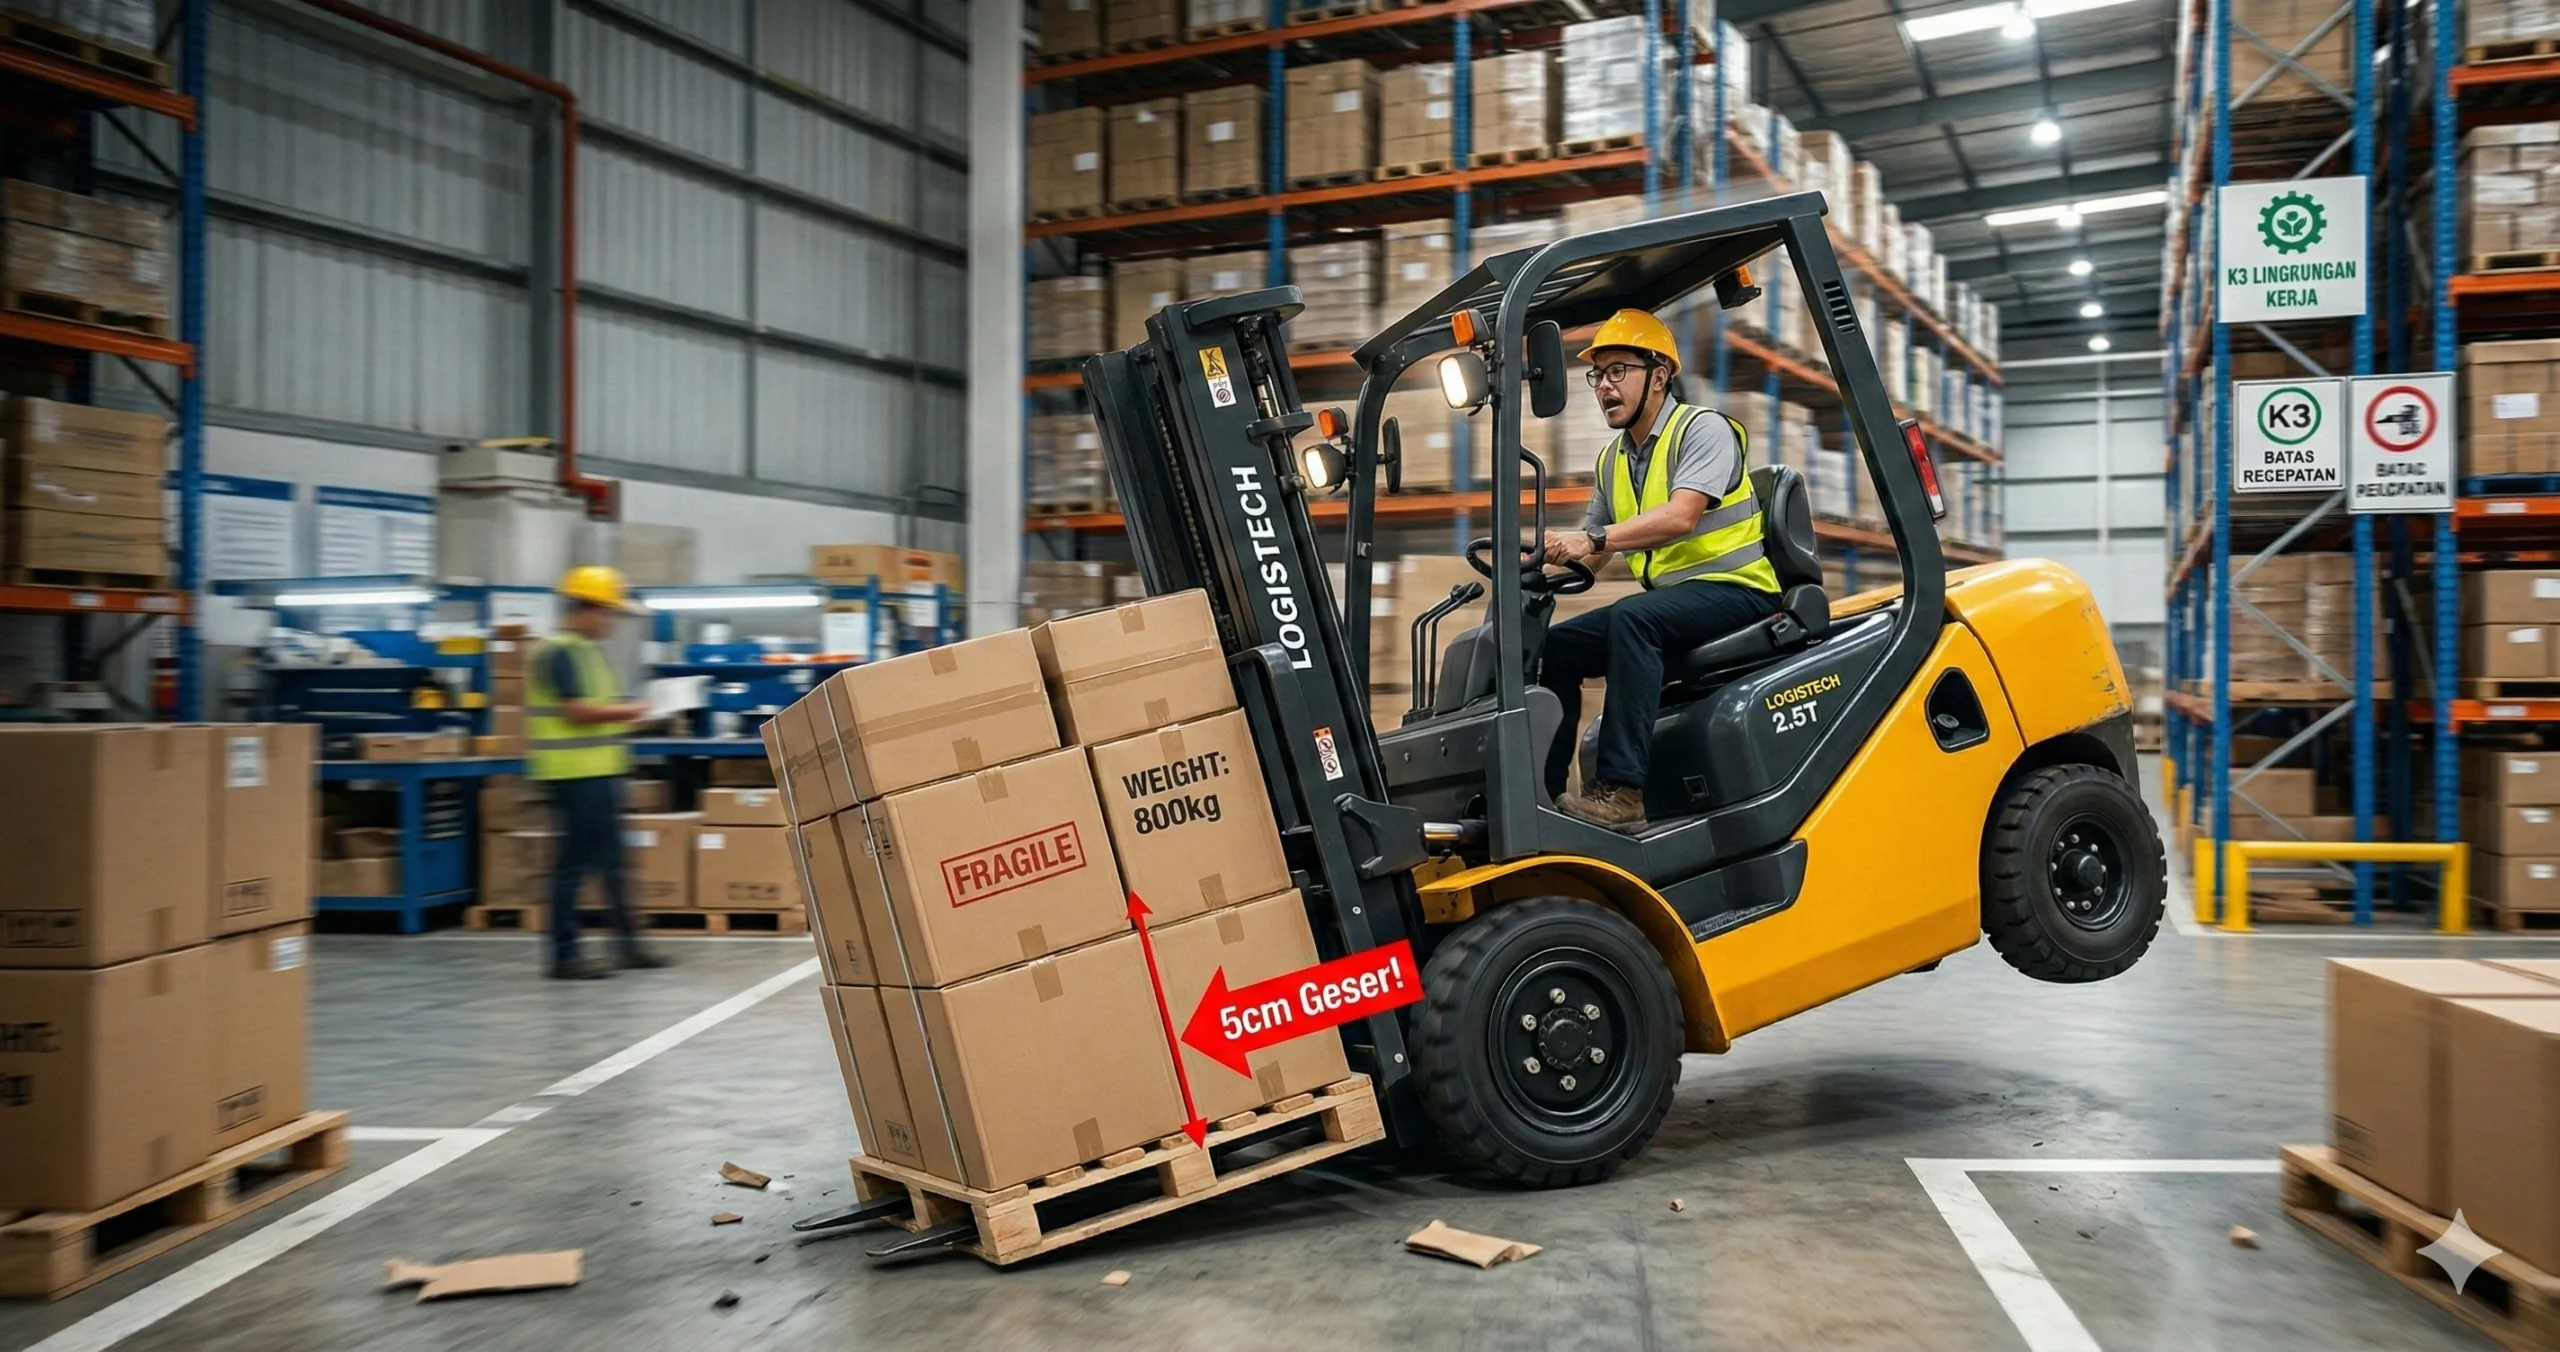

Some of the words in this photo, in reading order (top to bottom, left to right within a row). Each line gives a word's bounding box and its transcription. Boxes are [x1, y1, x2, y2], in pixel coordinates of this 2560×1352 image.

[2228, 268, 2248, 286] K3
[2253, 261, 2356, 284] LINGRUNGAN
[2266, 288, 2318, 307] KERJA
[2269, 403, 2311, 429] K3
[2264, 450, 2314, 464] BATAS
[1231, 466, 1313, 669] LOGISTECH
[1765, 674, 1841, 710] LOGISTECH
[1772, 700, 1817, 734] 2.5T
[1122, 751, 1229, 799] WEIGHT:
[1134, 794, 1221, 834] 800kg
[953, 832, 1077, 896] FRAGILE
